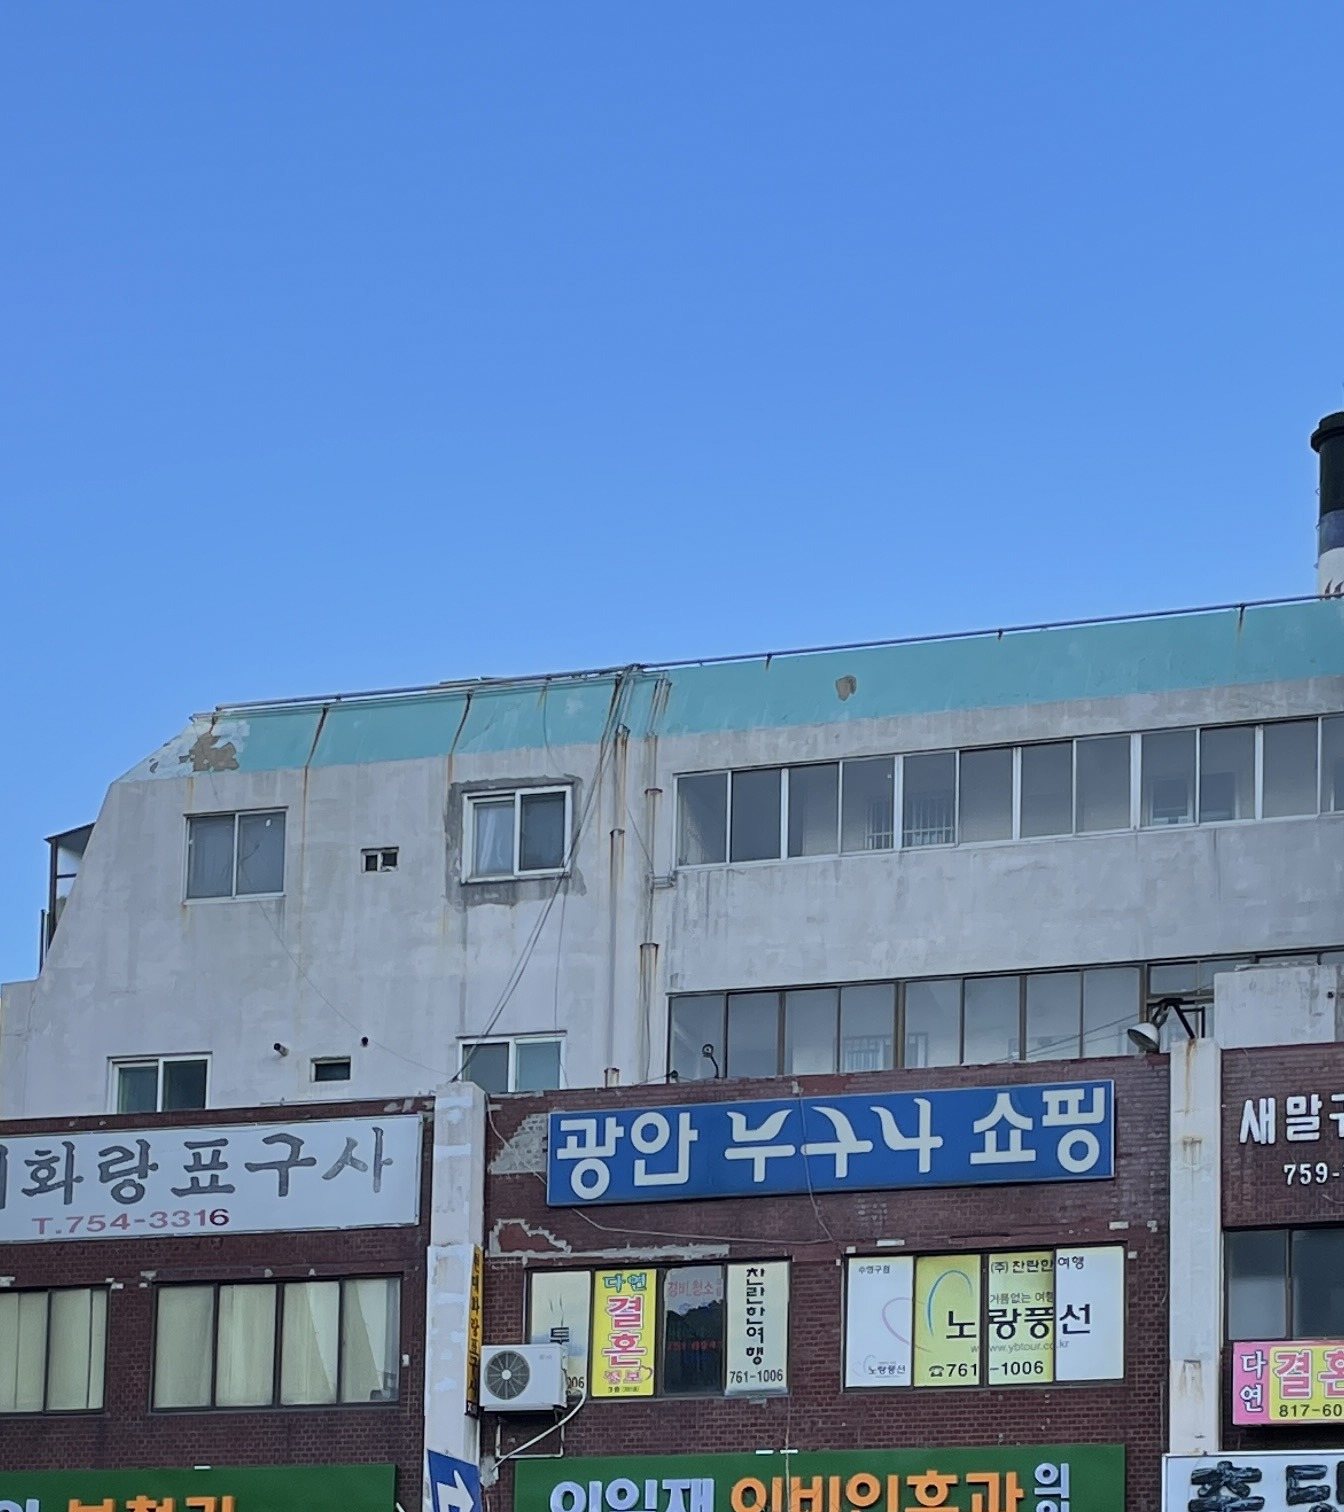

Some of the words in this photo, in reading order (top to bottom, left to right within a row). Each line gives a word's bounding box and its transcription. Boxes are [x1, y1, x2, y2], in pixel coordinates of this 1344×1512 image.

[556, 1111, 699, 1201] 광안
[969, 1085, 1106, 1175] 쇼핑
[31, 1207, 230, 1236] T.754-3316
[989, 1260, 1009, 1274] (주)
[601, 1295, 648, 1369] 결혼
[746, 1267, 766, 1366] 찬란한여행
[945, 1302, 1092, 1341] 노랑풍선
[729, 1368, 784, 1385] 761-1006
[945, 1360, 1044, 1378] 761-1006
[1240, 1350, 1268, 1413] 다연
